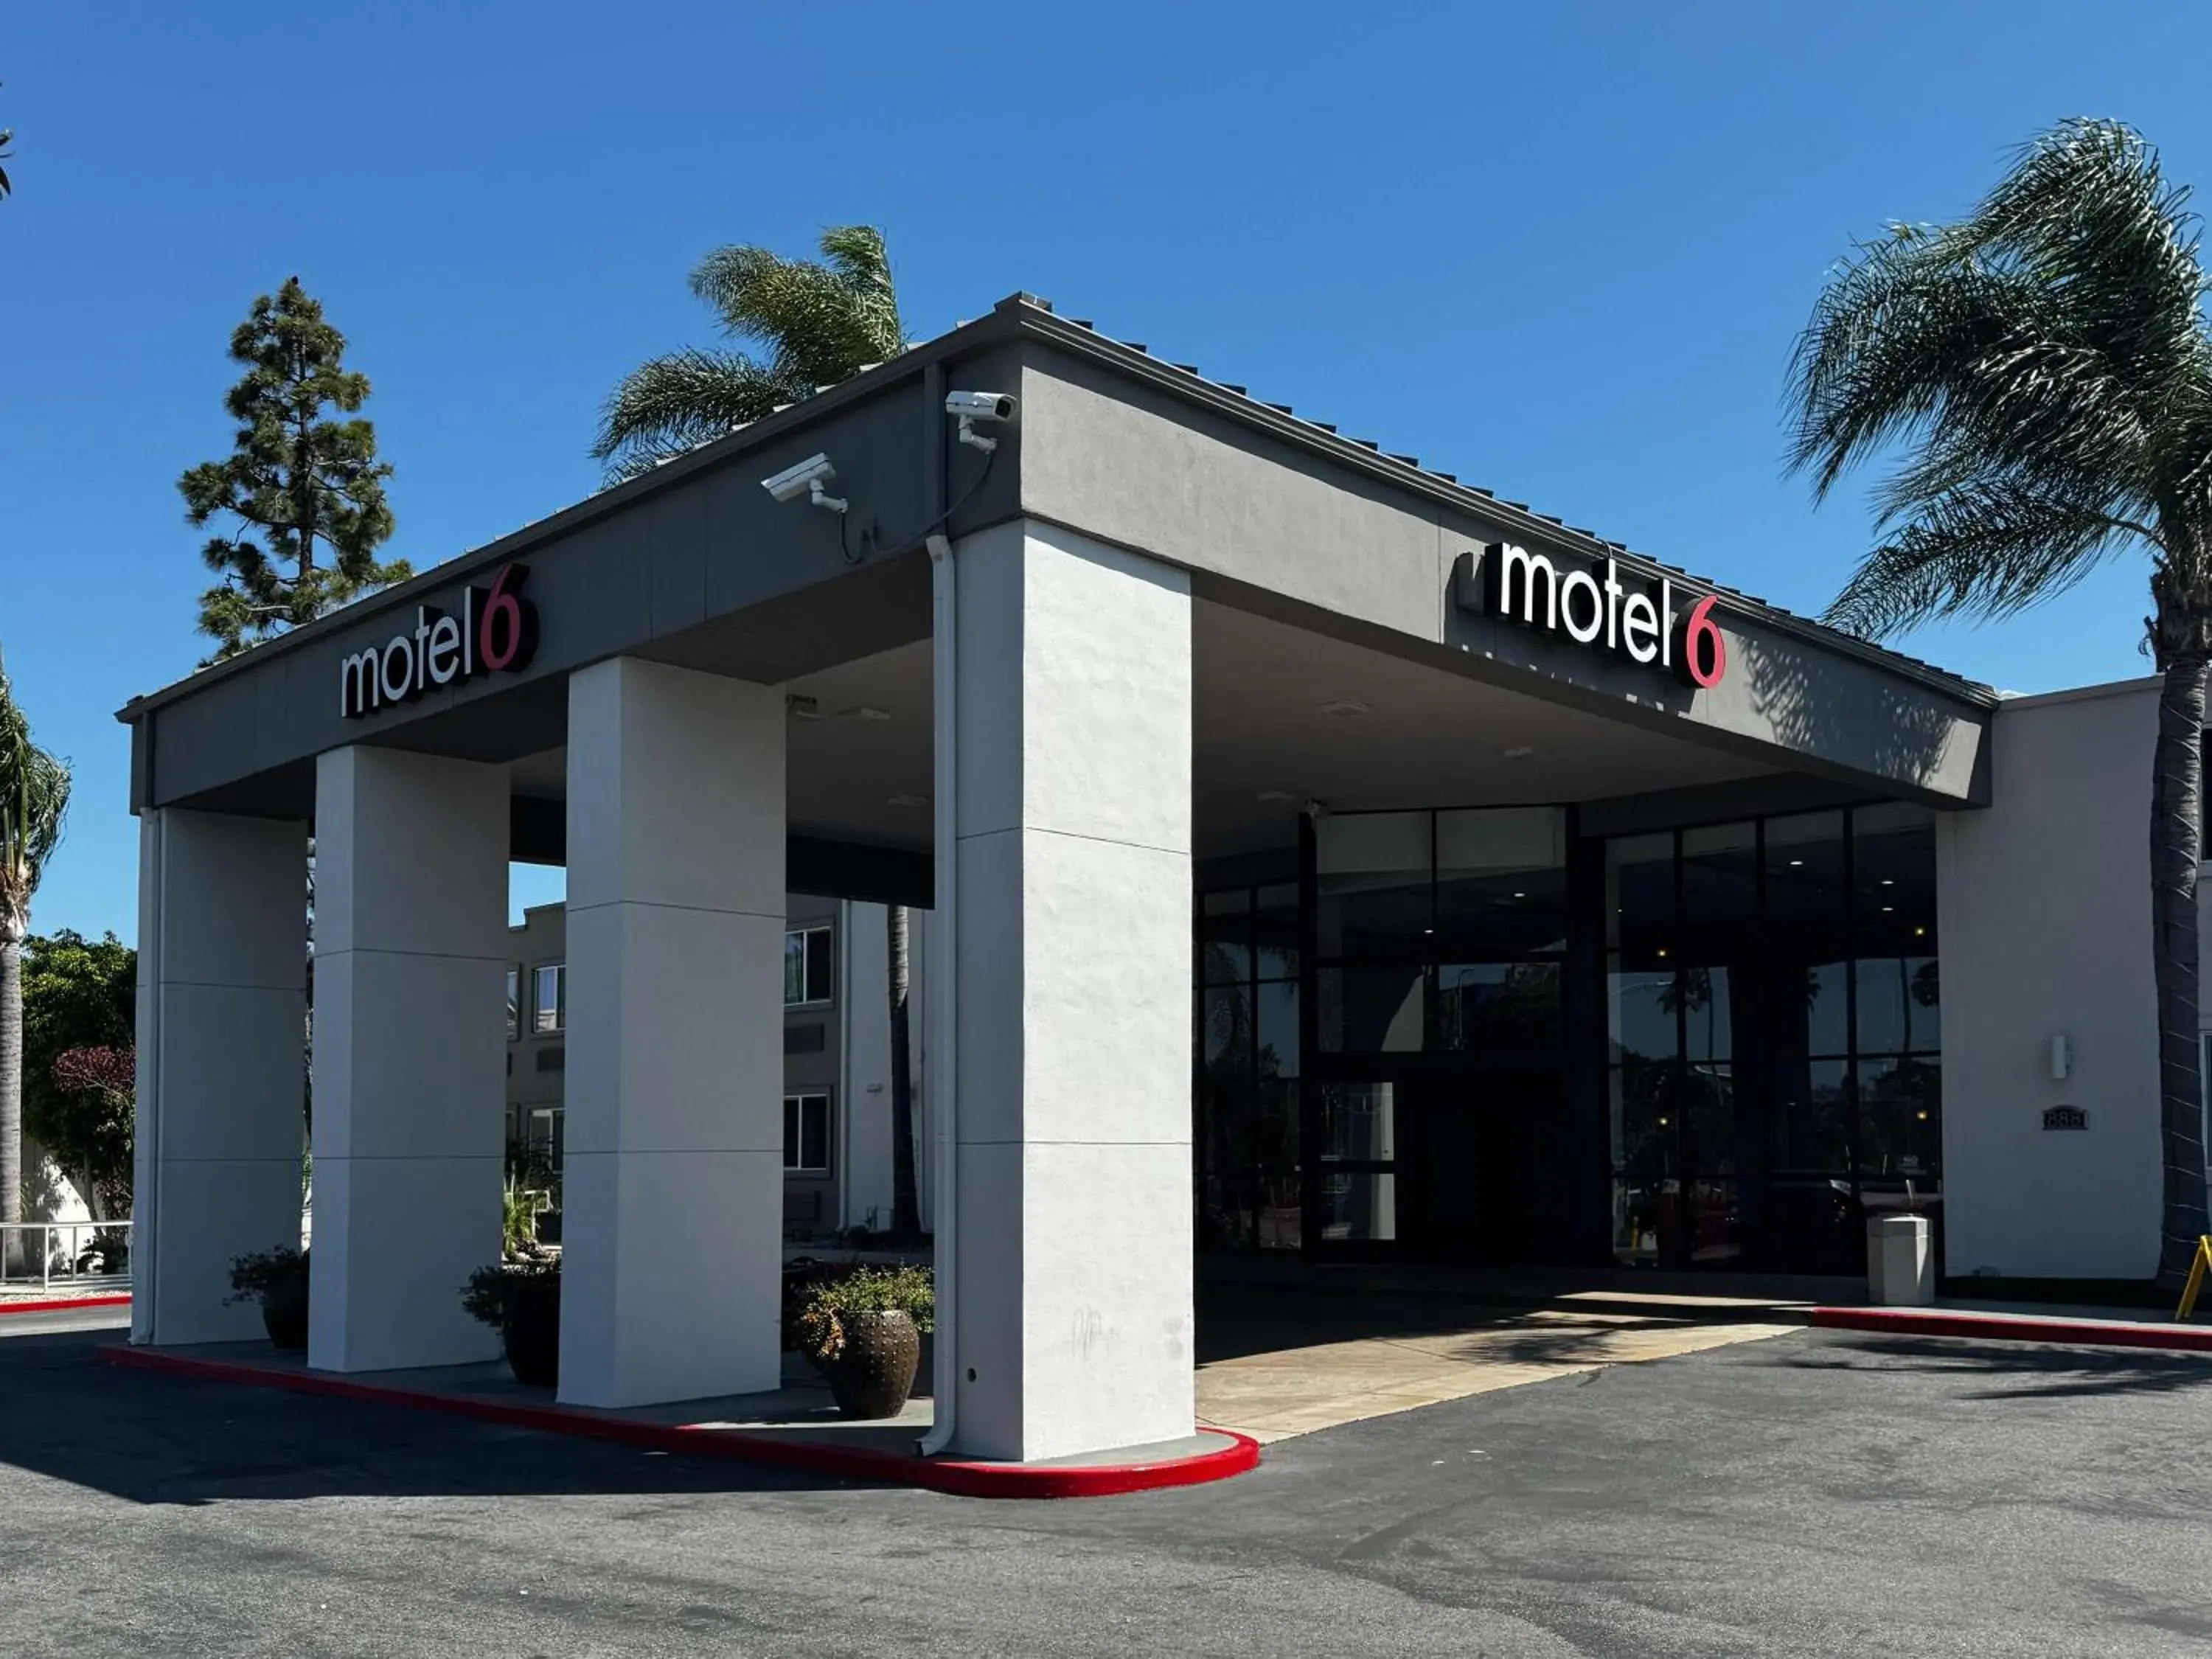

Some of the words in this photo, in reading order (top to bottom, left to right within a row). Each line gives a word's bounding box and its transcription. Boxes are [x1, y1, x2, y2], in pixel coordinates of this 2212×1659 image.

[341, 585, 472, 717] motel
[480, 562, 521, 670] 6
[1500, 542, 1670, 666] motel
[1686, 594, 1726, 689] 6
